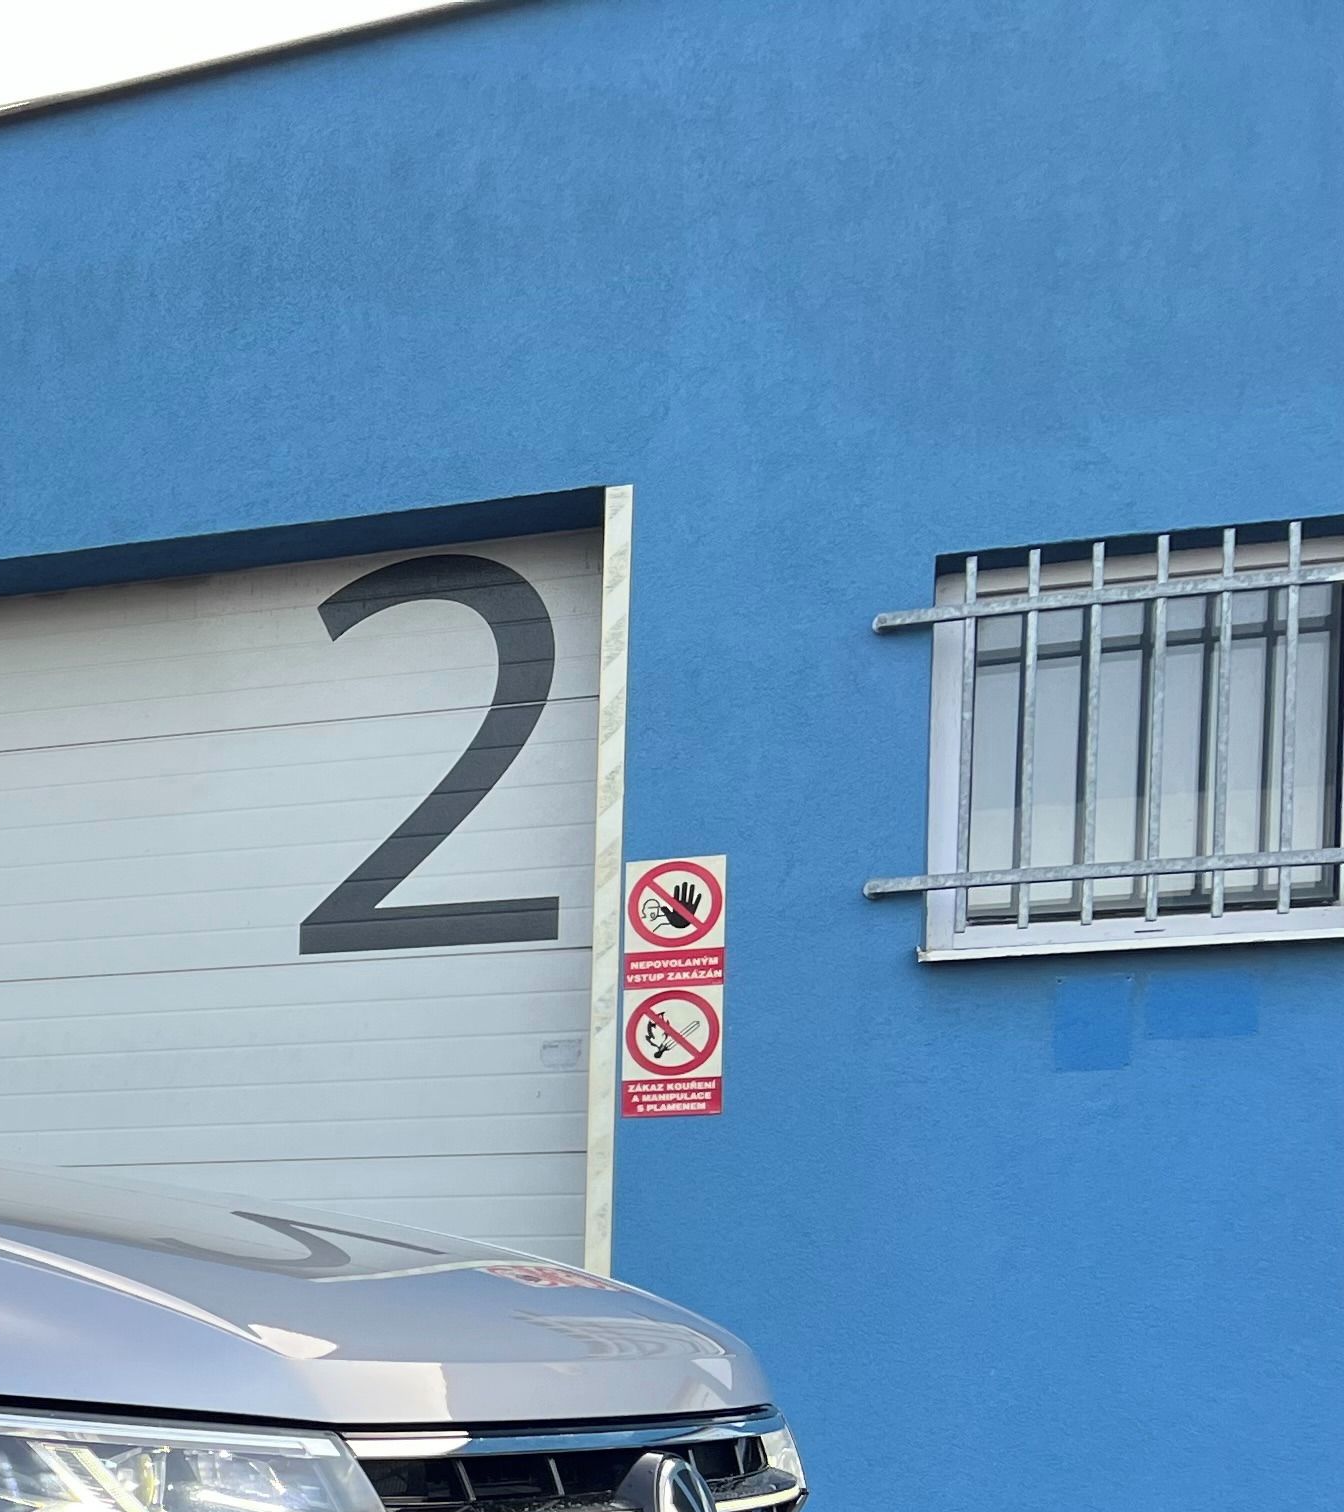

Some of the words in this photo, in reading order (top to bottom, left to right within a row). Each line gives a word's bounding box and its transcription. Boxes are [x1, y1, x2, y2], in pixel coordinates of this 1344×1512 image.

[299, 554, 560, 955] 2
[630, 955, 719, 970] NEPOVOLANÝM
[627, 972, 664, 983] VSTUP
[666, 967, 723, 981] ZAKÁZÁN
[627, 1083, 664, 1093] ZÁKAZ
[666, 1079, 716, 1091] KOUŘENÍ
[631, 1094, 640, 1103] A
[641, 1091, 712, 1102] MANIPULACE
[636, 1104, 644, 1113] S
[646, 1101, 706, 1112] PLAMENEM
